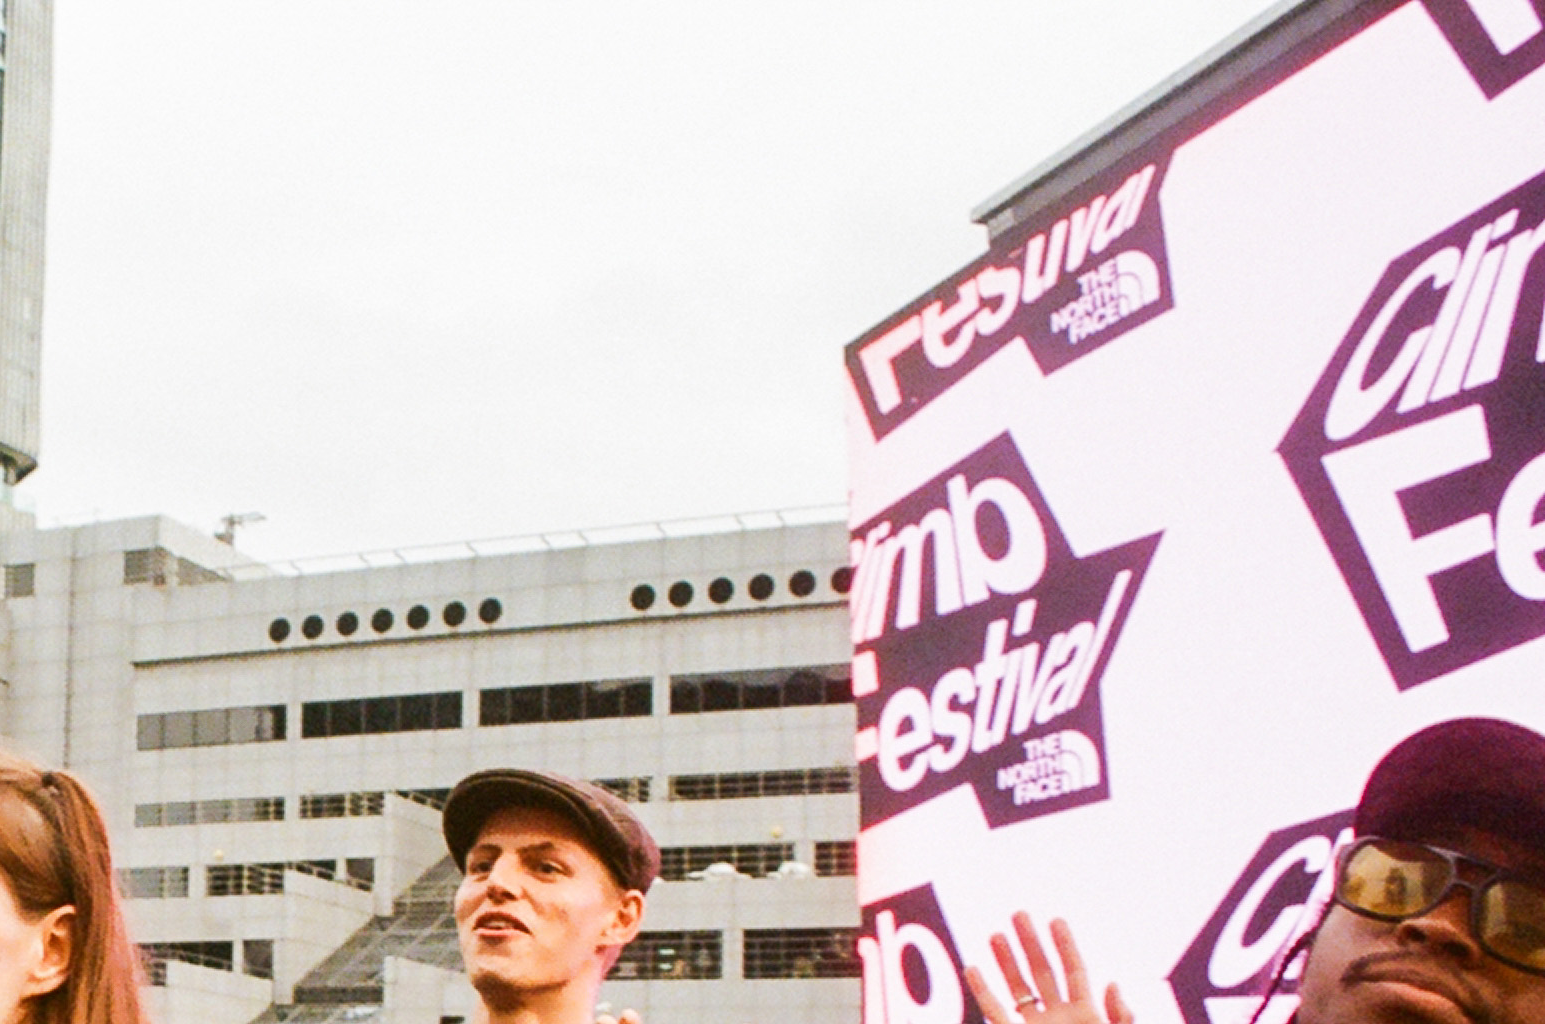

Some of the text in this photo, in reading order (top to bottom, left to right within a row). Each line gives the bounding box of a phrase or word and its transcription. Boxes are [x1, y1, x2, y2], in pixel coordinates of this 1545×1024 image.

[1050, 279, 1118, 334] NORTH
[1067, 299, 1119, 345] FACE
[850, 472, 1049, 644] limb
[996, 756, 1060, 791] NORTH
[1013, 776, 1062, 806] FACE
